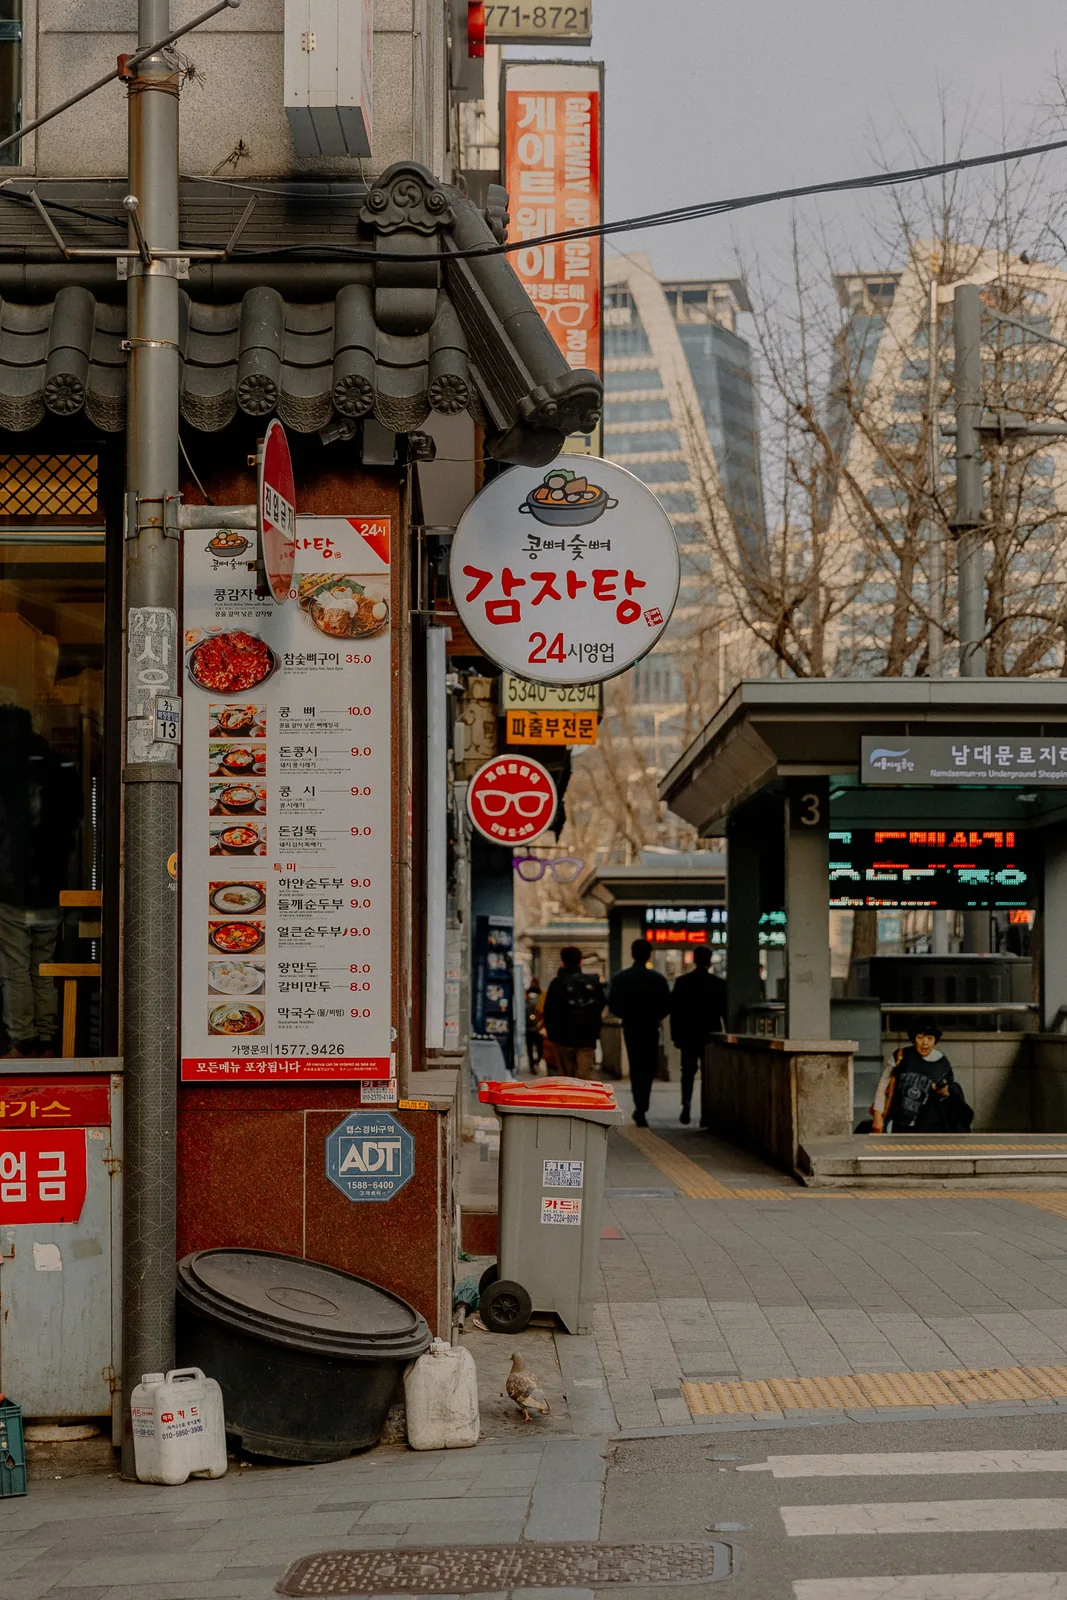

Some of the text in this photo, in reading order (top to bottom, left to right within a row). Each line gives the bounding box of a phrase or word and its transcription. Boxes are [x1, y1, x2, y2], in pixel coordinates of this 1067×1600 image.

[565, 97, 591, 192] GATEWAY
[517, 97, 556, 279] 게이트웨이
[360, 523, 386, 537] 24시
[294, 538, 335, 559] 자탕
[521, 533, 612, 560] 콩뼈숯뼈
[462, 565, 647, 625] 감자탕
[284, 653, 372, 665] 참숯뼈구이 35.0
[348, 706, 372, 716] 10.0
[160, 722, 176, 738] 13
[512, 718, 593, 738] 파출부전문
[279, 746, 372, 758] 돈콩시 9.0
[930, 770, 986, 778] Namdaemun-ro
[988, 770, 1036, 779] Underground
[304, 786, 316, 797] 시
[351, 786, 372, 796] 9.0
[800, 794, 820, 825] 3
[278, 826, 372, 836] 돈김뚝 9.0
[350, 878, 370, 888] 9.0
[277, 899, 370, 910] 들깨순두부 9.0
[277, 926, 370, 937] 얼큰순두부 9.0
[278, 962, 370, 974] 왕만두 8.0
[278, 981, 370, 992] 갈비만두 8.0
[350, 1008, 370, 1018] 9.0
[232, 1044, 344, 1056] 가맹문의 1577.9426
[196, 1062, 300, 1073] 모든메뉴 포장됩니다
[340, 1142, 401, 1172] ADT
[347, 1182, 394, 1190] 1588-6400
